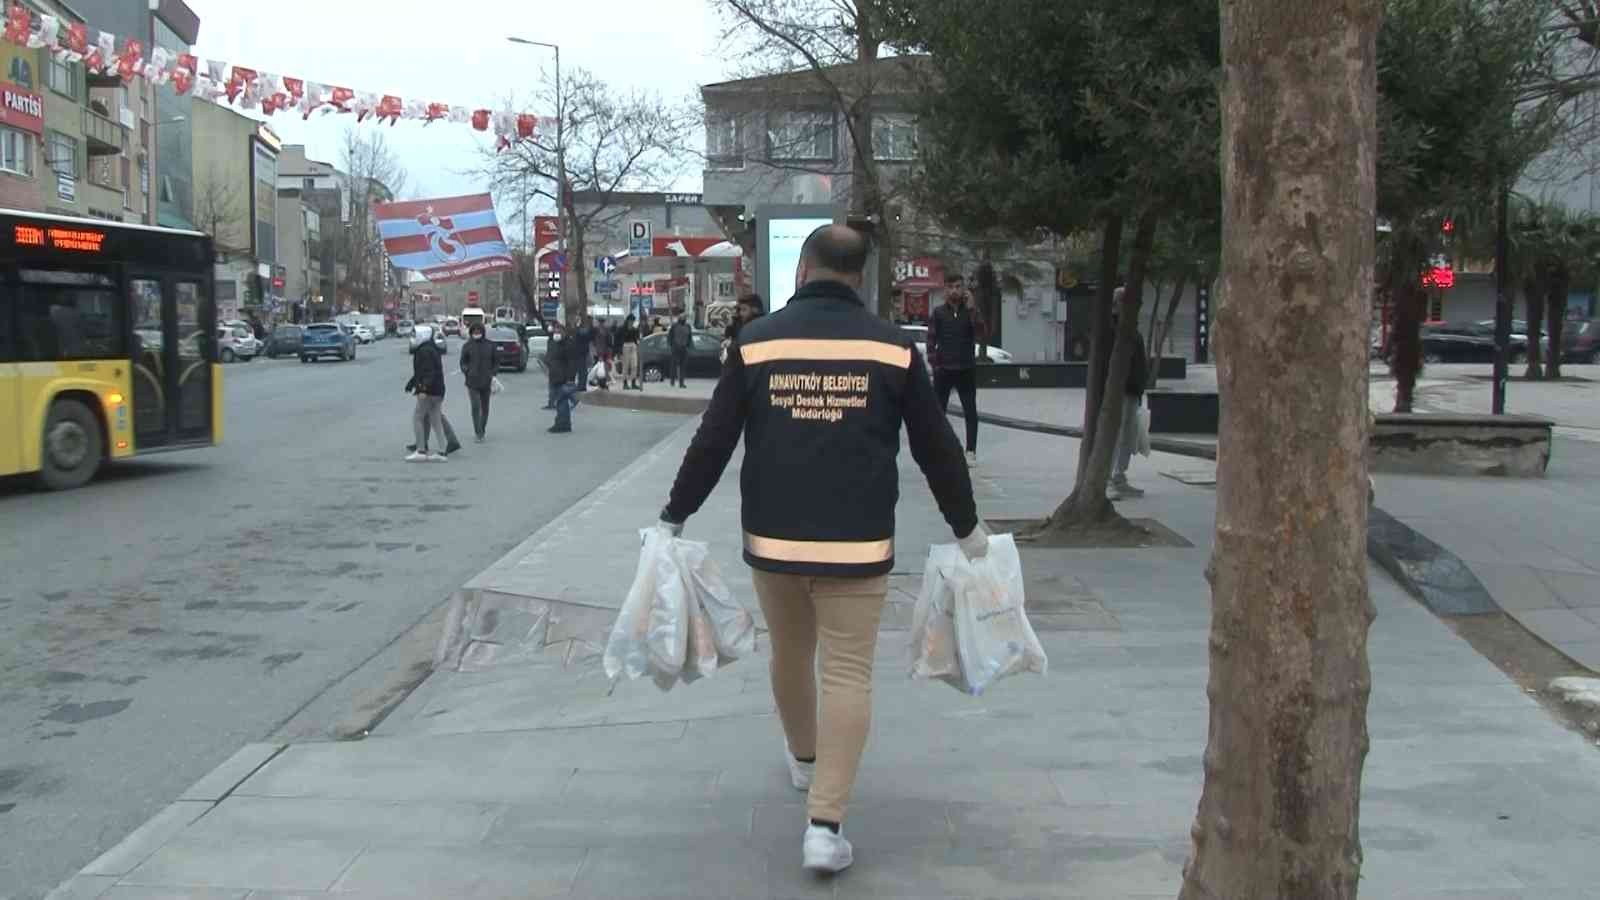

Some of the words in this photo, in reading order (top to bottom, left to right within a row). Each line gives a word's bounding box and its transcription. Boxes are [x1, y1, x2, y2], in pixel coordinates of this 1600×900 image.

[633, 222, 646, 239] D
[769, 372, 821, 390] ARNAVUTKÖY
[823, 372, 869, 392] BELEDİYESİ
[770, 393, 794, 408] Sosyal
[796, 393, 824, 407] Destek
[827, 394, 867, 408] Hizmetleri
[791, 406, 842, 422] Müdürlüğü
